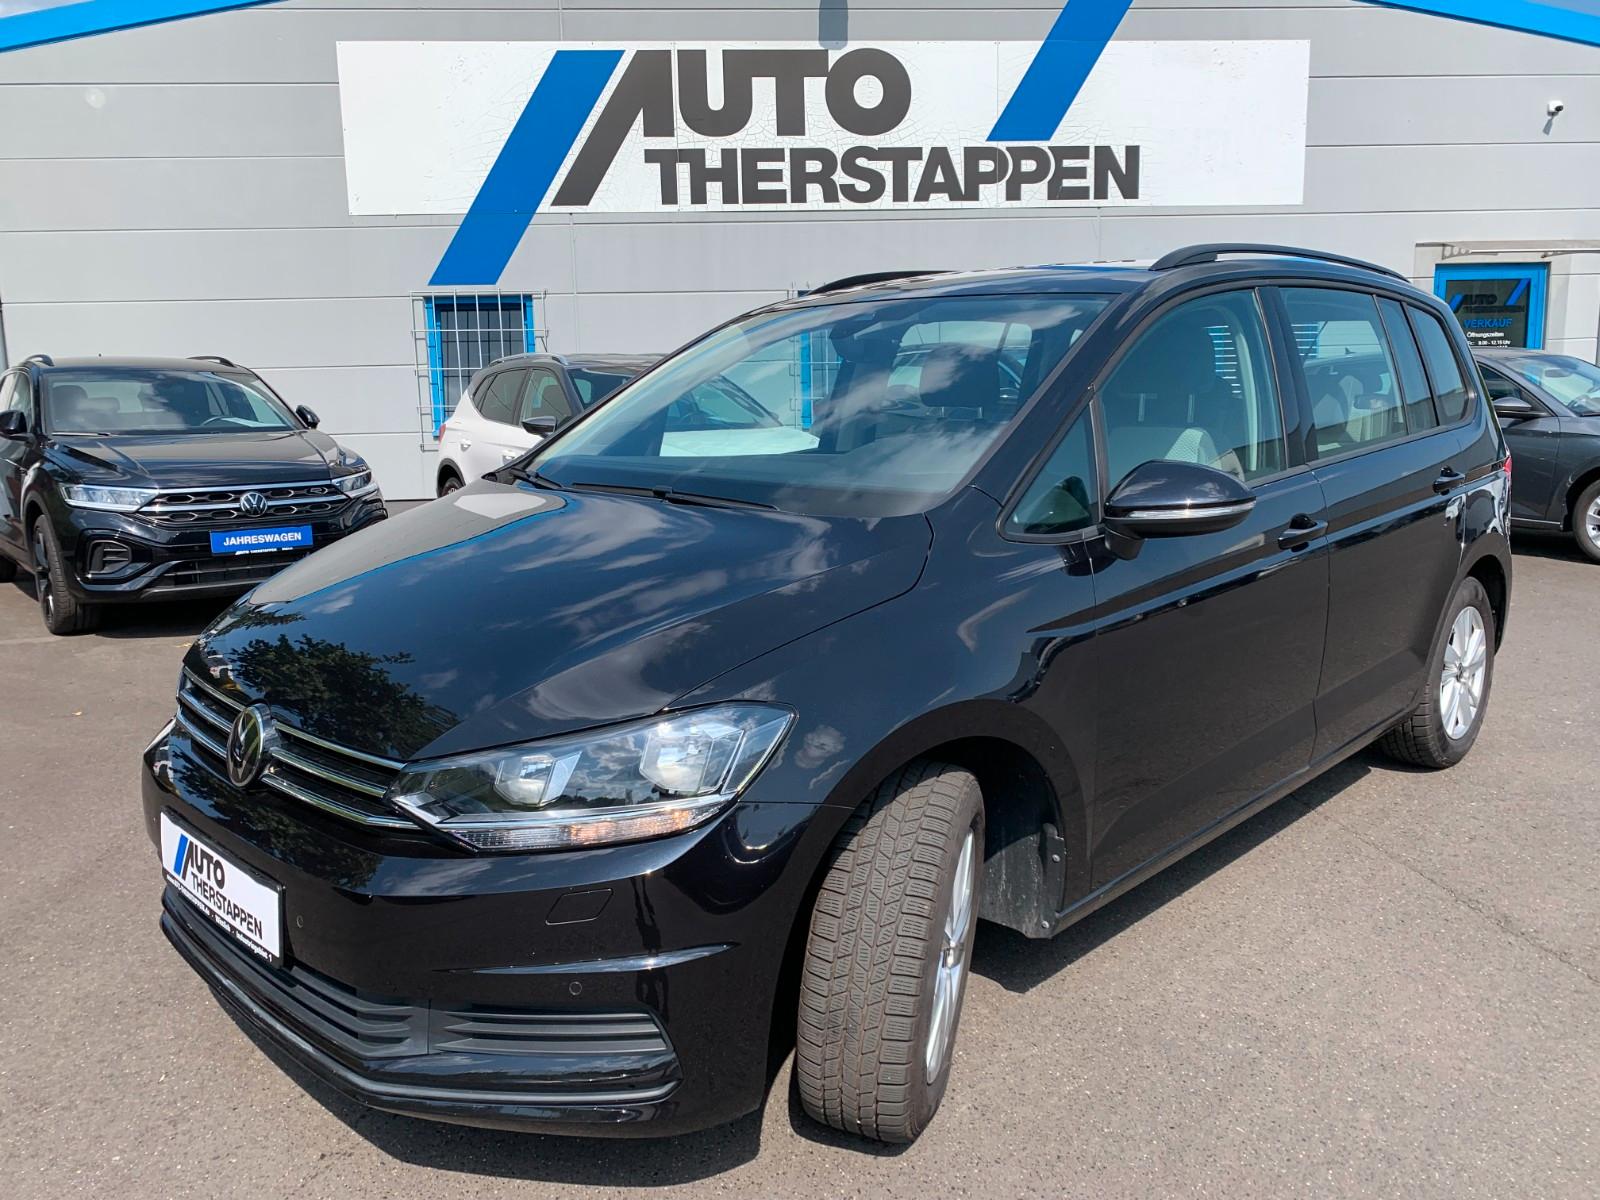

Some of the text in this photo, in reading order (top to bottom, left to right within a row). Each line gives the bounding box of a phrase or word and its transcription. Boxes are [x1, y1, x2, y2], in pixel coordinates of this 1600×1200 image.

[550, 48, 911, 206] AUTO
[644, 145, 1139, 206] THERSTAPPEN
[1464, 319, 1512, 328] VERKAUF
[224, 532, 302, 546] JAHRESWAGEN
[181, 841, 226, 890] AUTO
[191, 872, 263, 941] THERSTAPPEN
